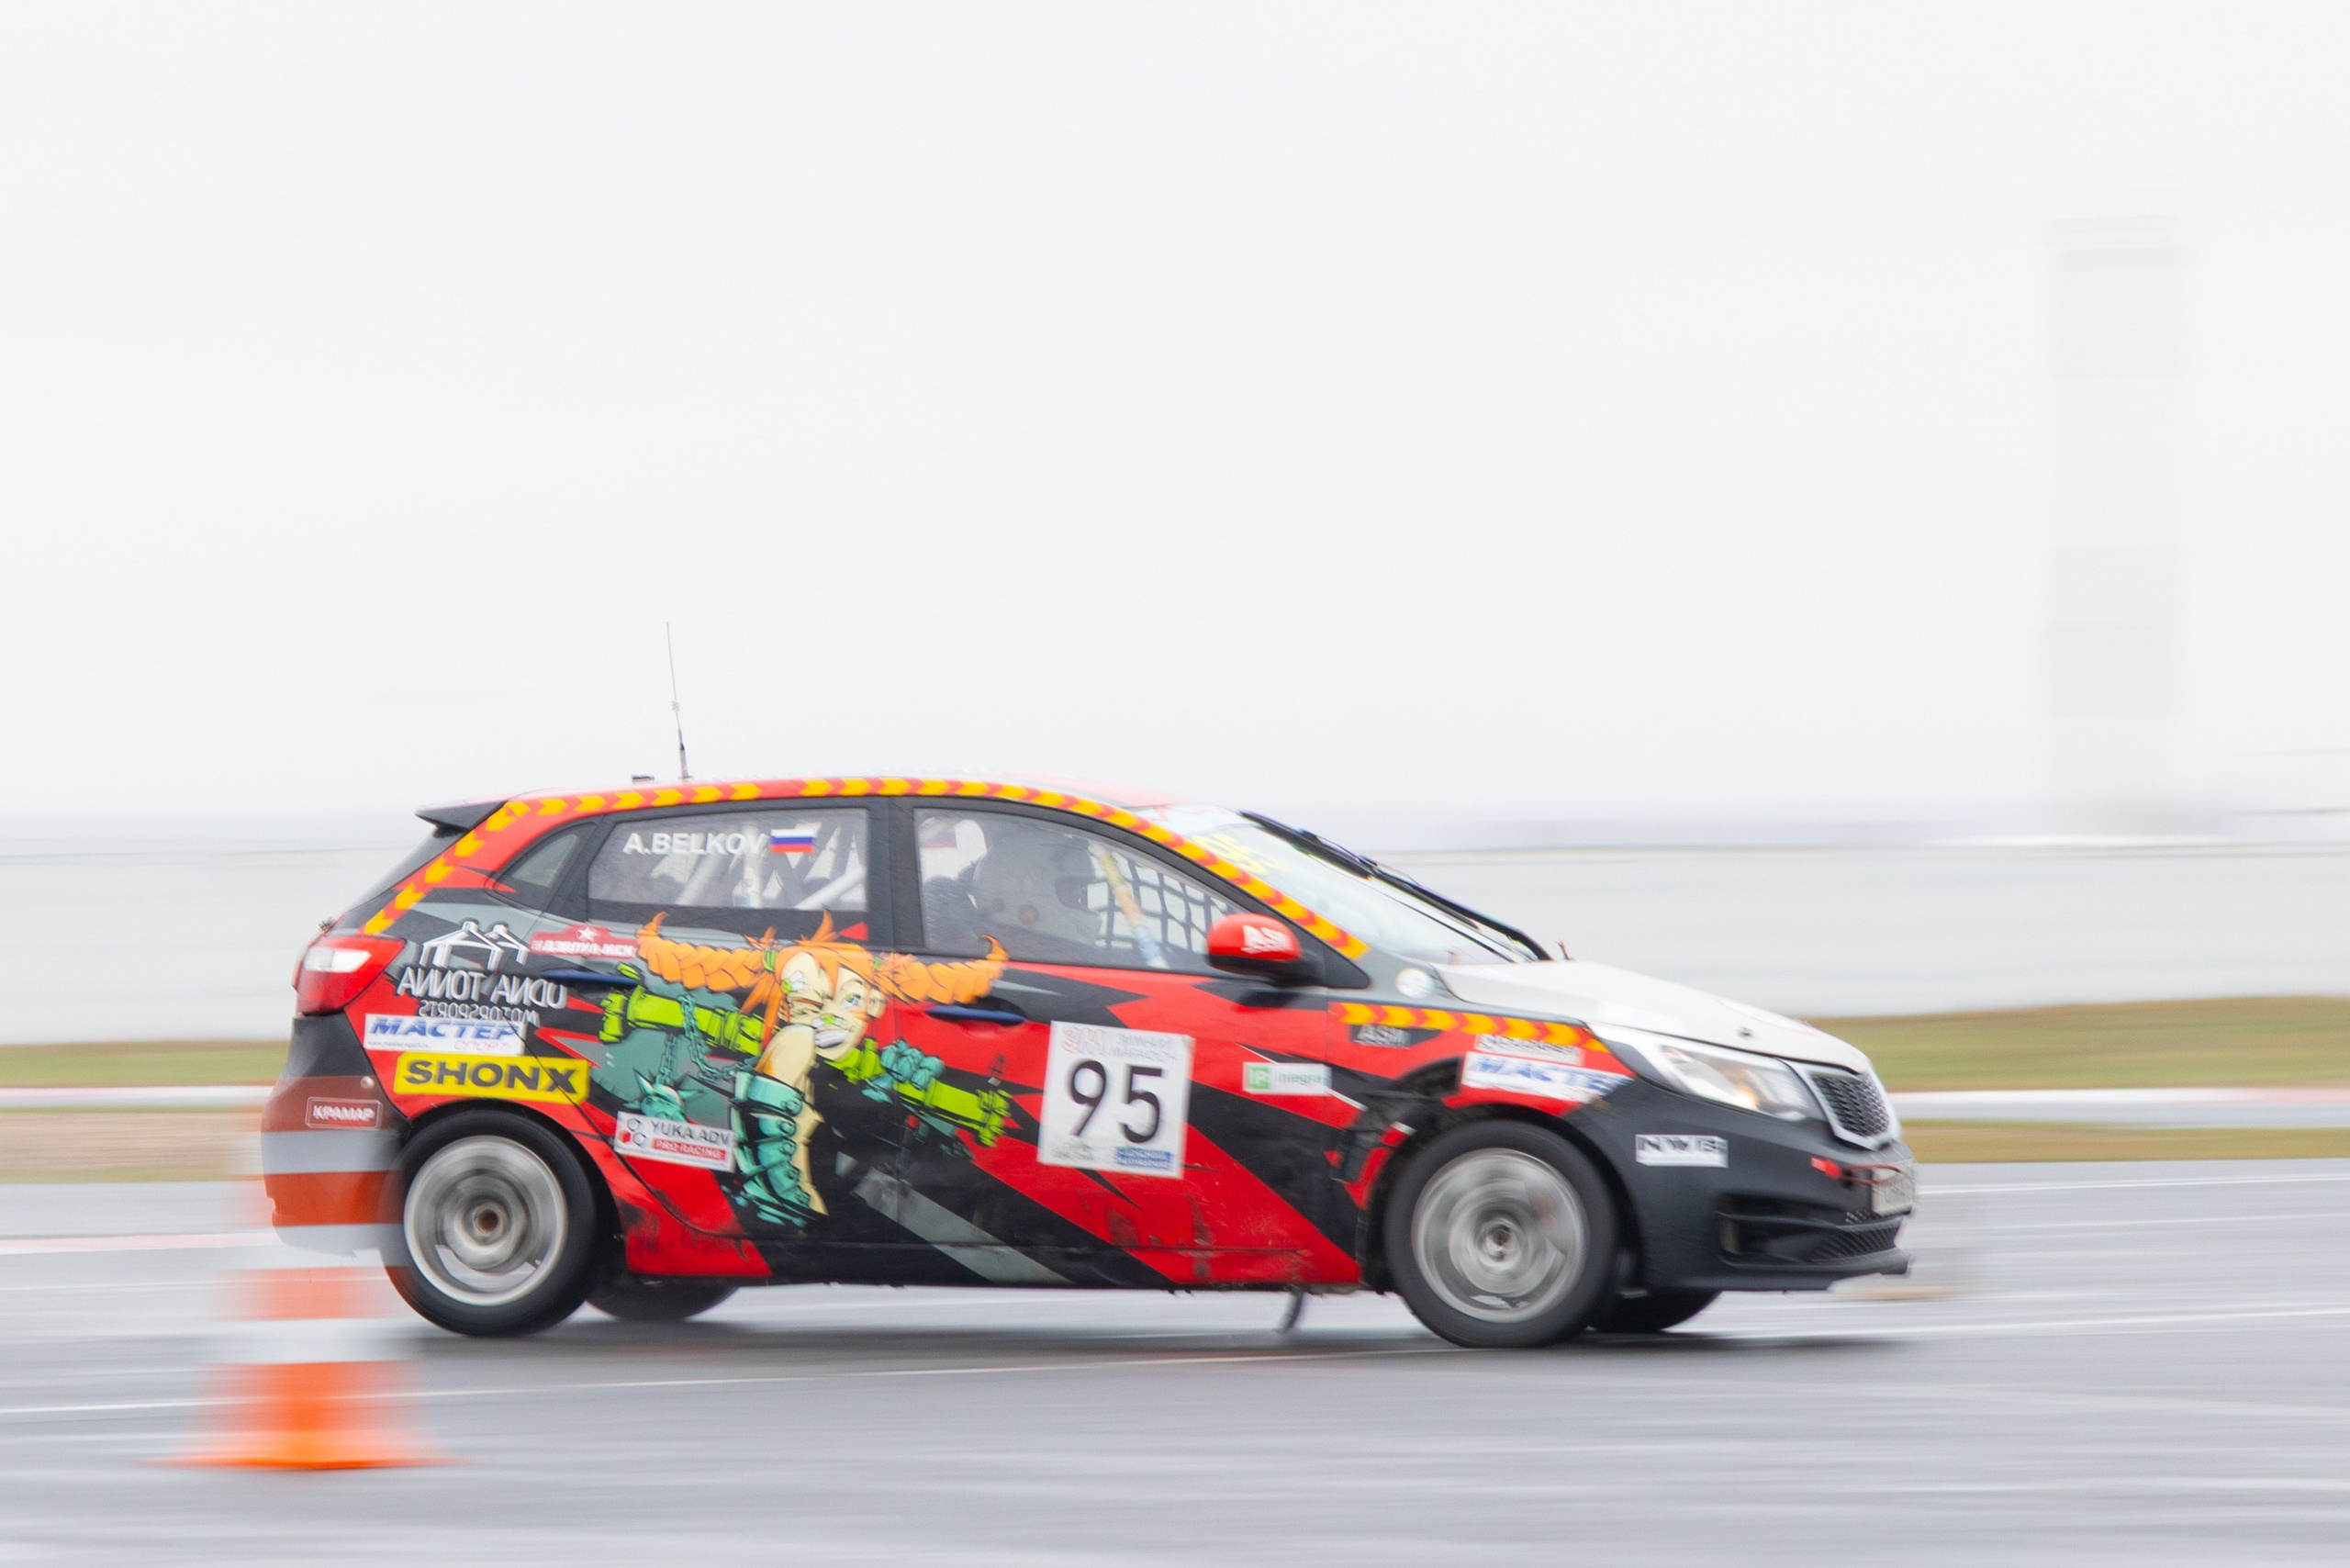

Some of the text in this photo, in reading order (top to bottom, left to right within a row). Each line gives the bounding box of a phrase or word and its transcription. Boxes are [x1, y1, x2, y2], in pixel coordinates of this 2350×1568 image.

[622, 832, 768, 856] A.BELKOV
[405, 1059, 577, 1095] SHONX
[1067, 1058, 1165, 1144] 95
[651, 1120, 695, 1140] YUKA
